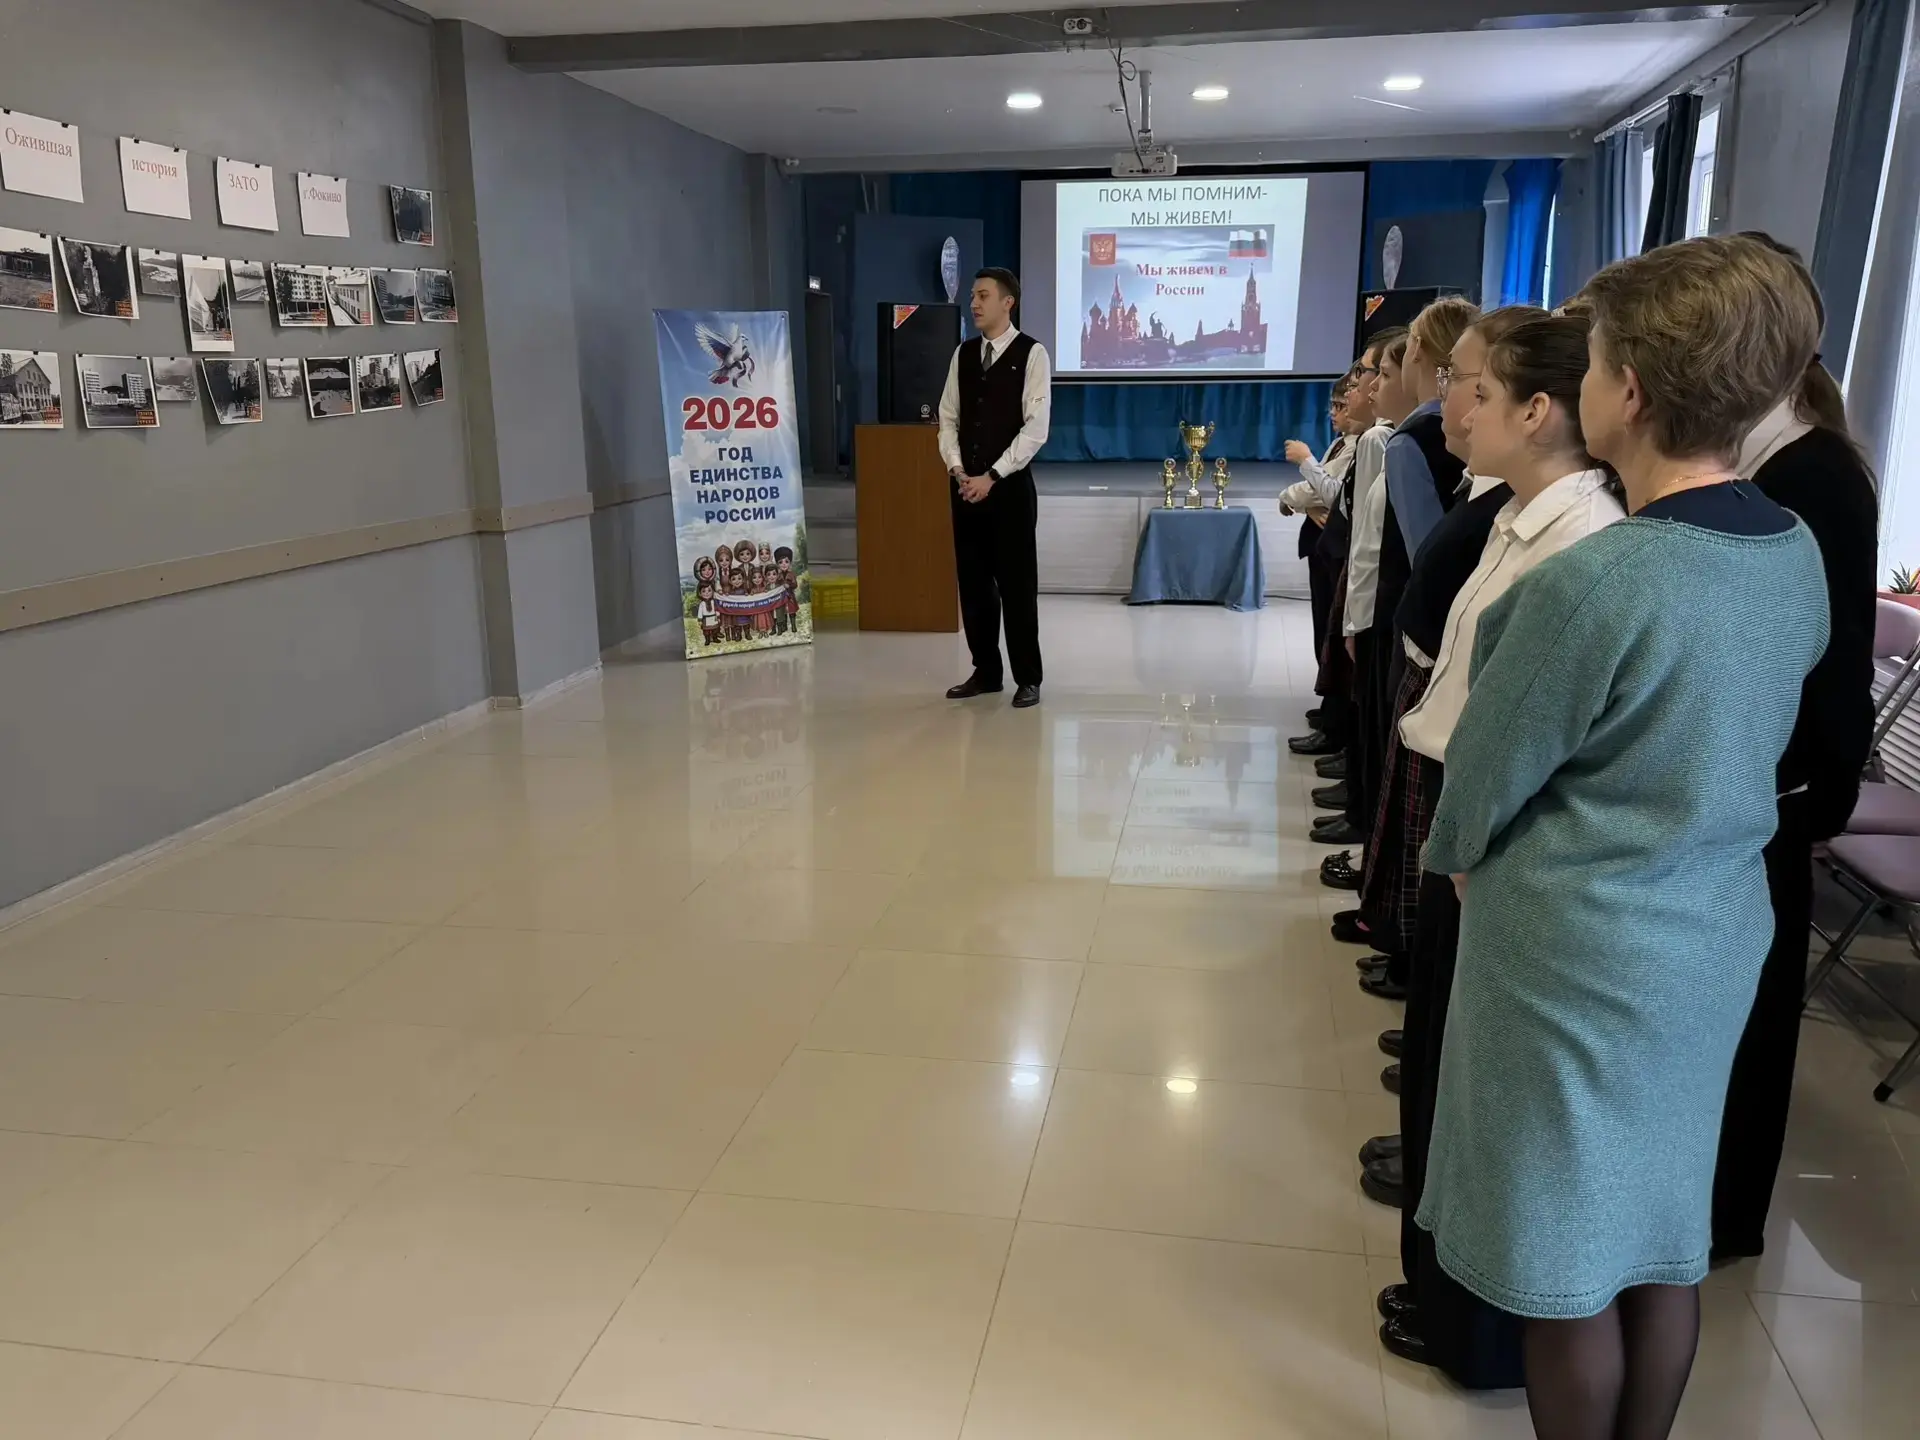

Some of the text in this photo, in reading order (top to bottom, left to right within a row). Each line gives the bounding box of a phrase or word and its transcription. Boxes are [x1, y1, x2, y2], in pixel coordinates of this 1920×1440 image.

[4, 126, 74, 158] Ожившая
[131, 158, 178, 180] история
[228, 172, 260, 193] ЗАТО
[302, 186, 343, 204] г.Фокино
[1098, 185, 1268, 203] ПОКА МЫ ПОМНИМ-
[1131, 209, 1233, 226] МЫ ЖИВЕМ!
[1136, 263, 1228, 276] Мы живем в
[1155, 283, 1205, 296] России
[682, 396, 780, 431] 2026
[718, 446, 754, 463] ГОД
[689, 465, 784, 486] ЕДИНСТВА
[696, 486, 780, 504] НАРОДОВ
[704, 506, 776, 525] РОССИИ
